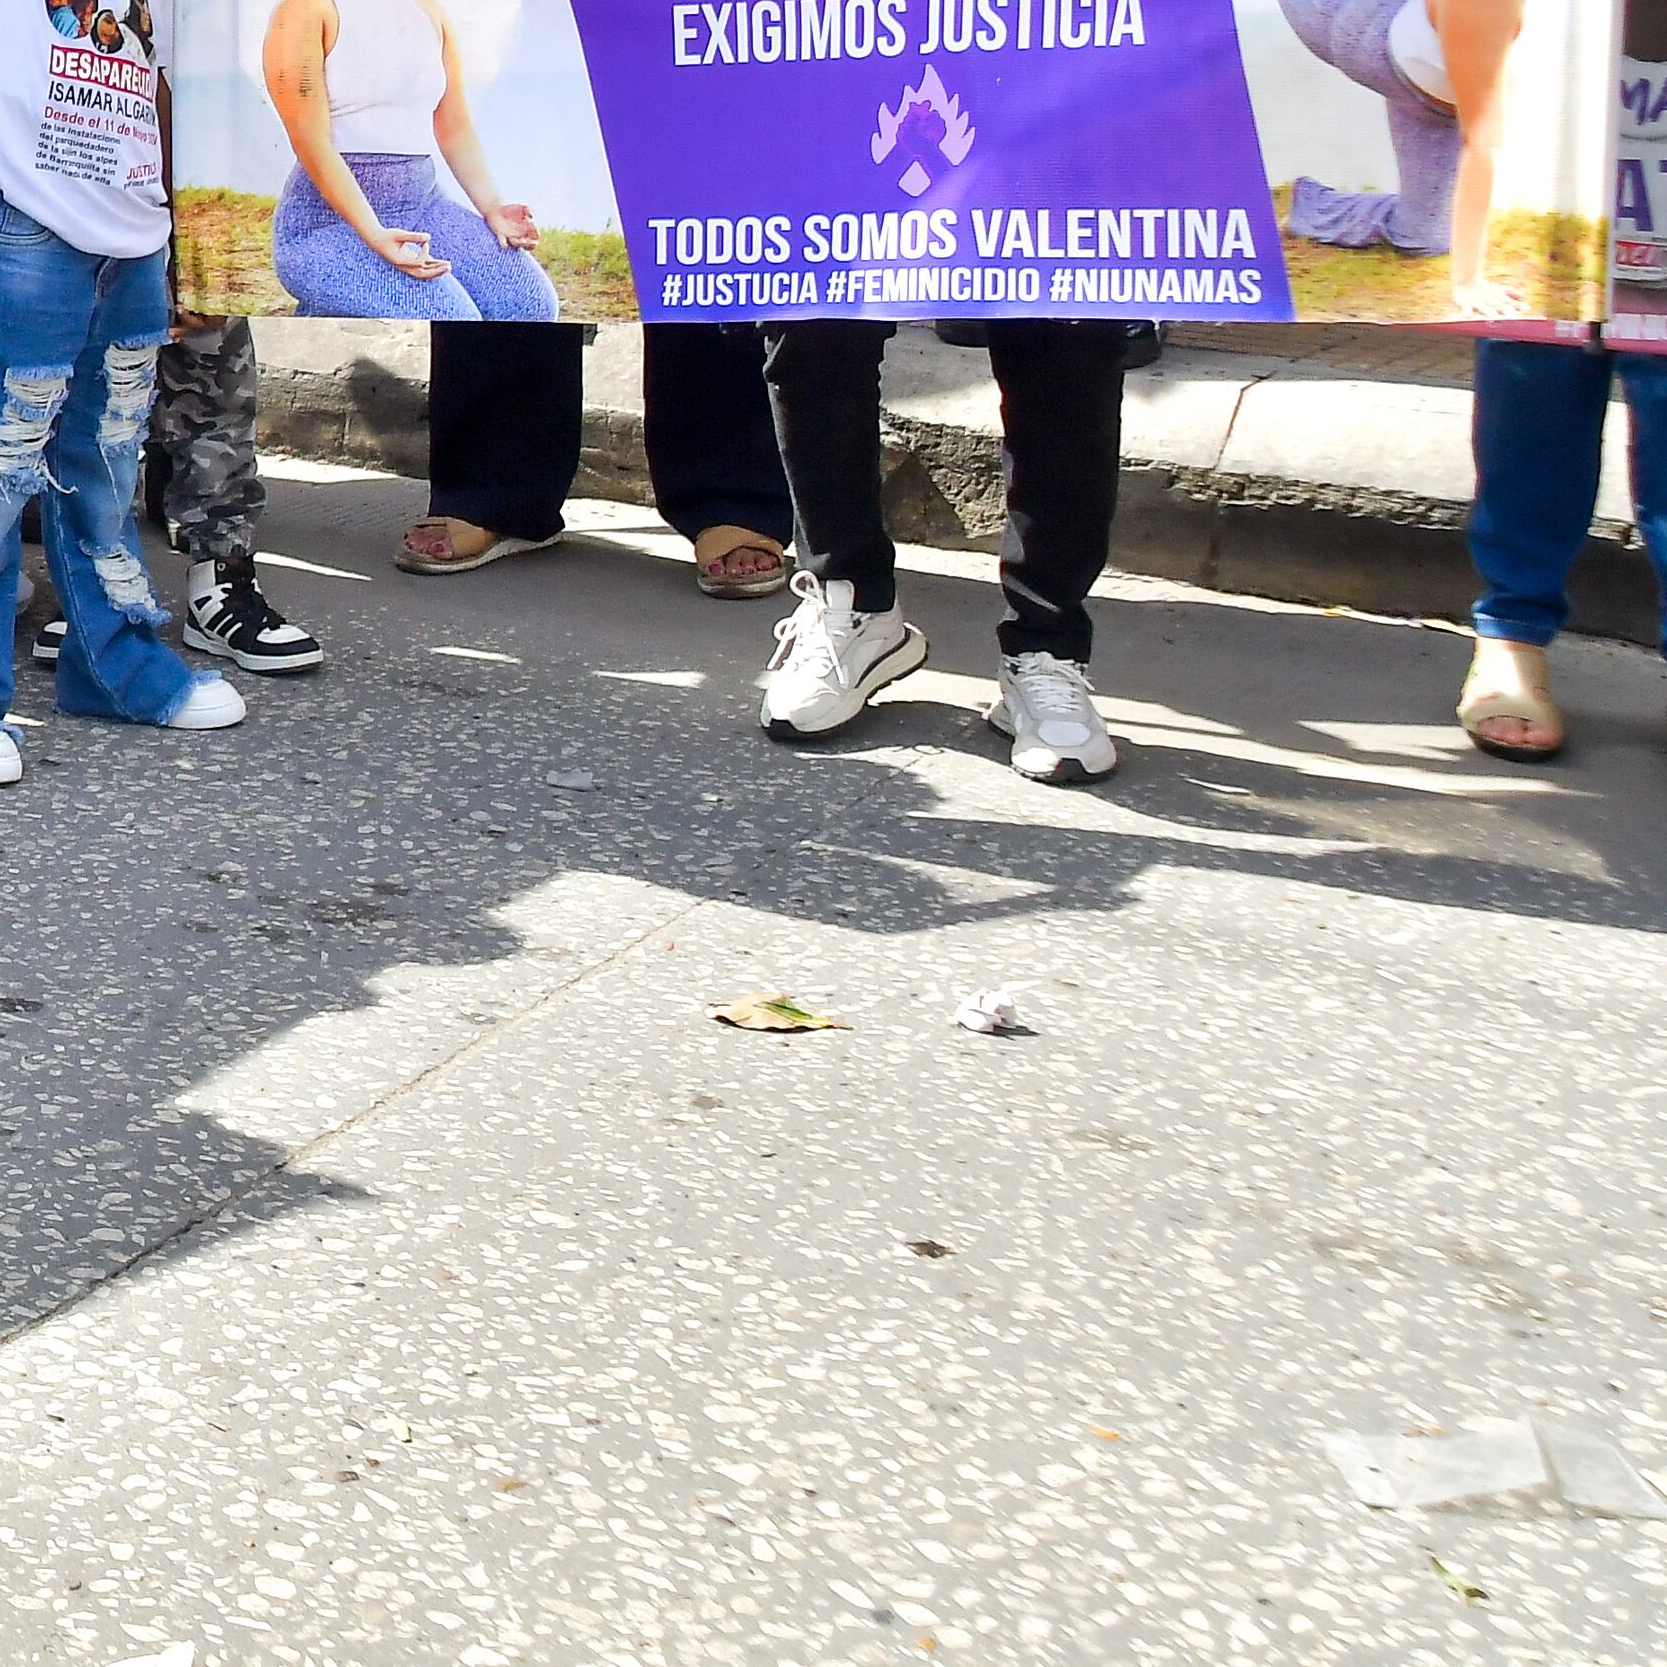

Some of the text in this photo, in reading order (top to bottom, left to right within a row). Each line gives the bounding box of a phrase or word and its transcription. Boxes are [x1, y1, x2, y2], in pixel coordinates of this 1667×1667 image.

[48, 80, 113, 113] ISAMAR
[44, 105, 85, 126] Desde
[647, 207, 1258, 266] TODOS SOMOS VALENTINA
[661, 266, 1263, 307] #JUSTUCIA #FEMINICIDIO #NIUNAMAS
